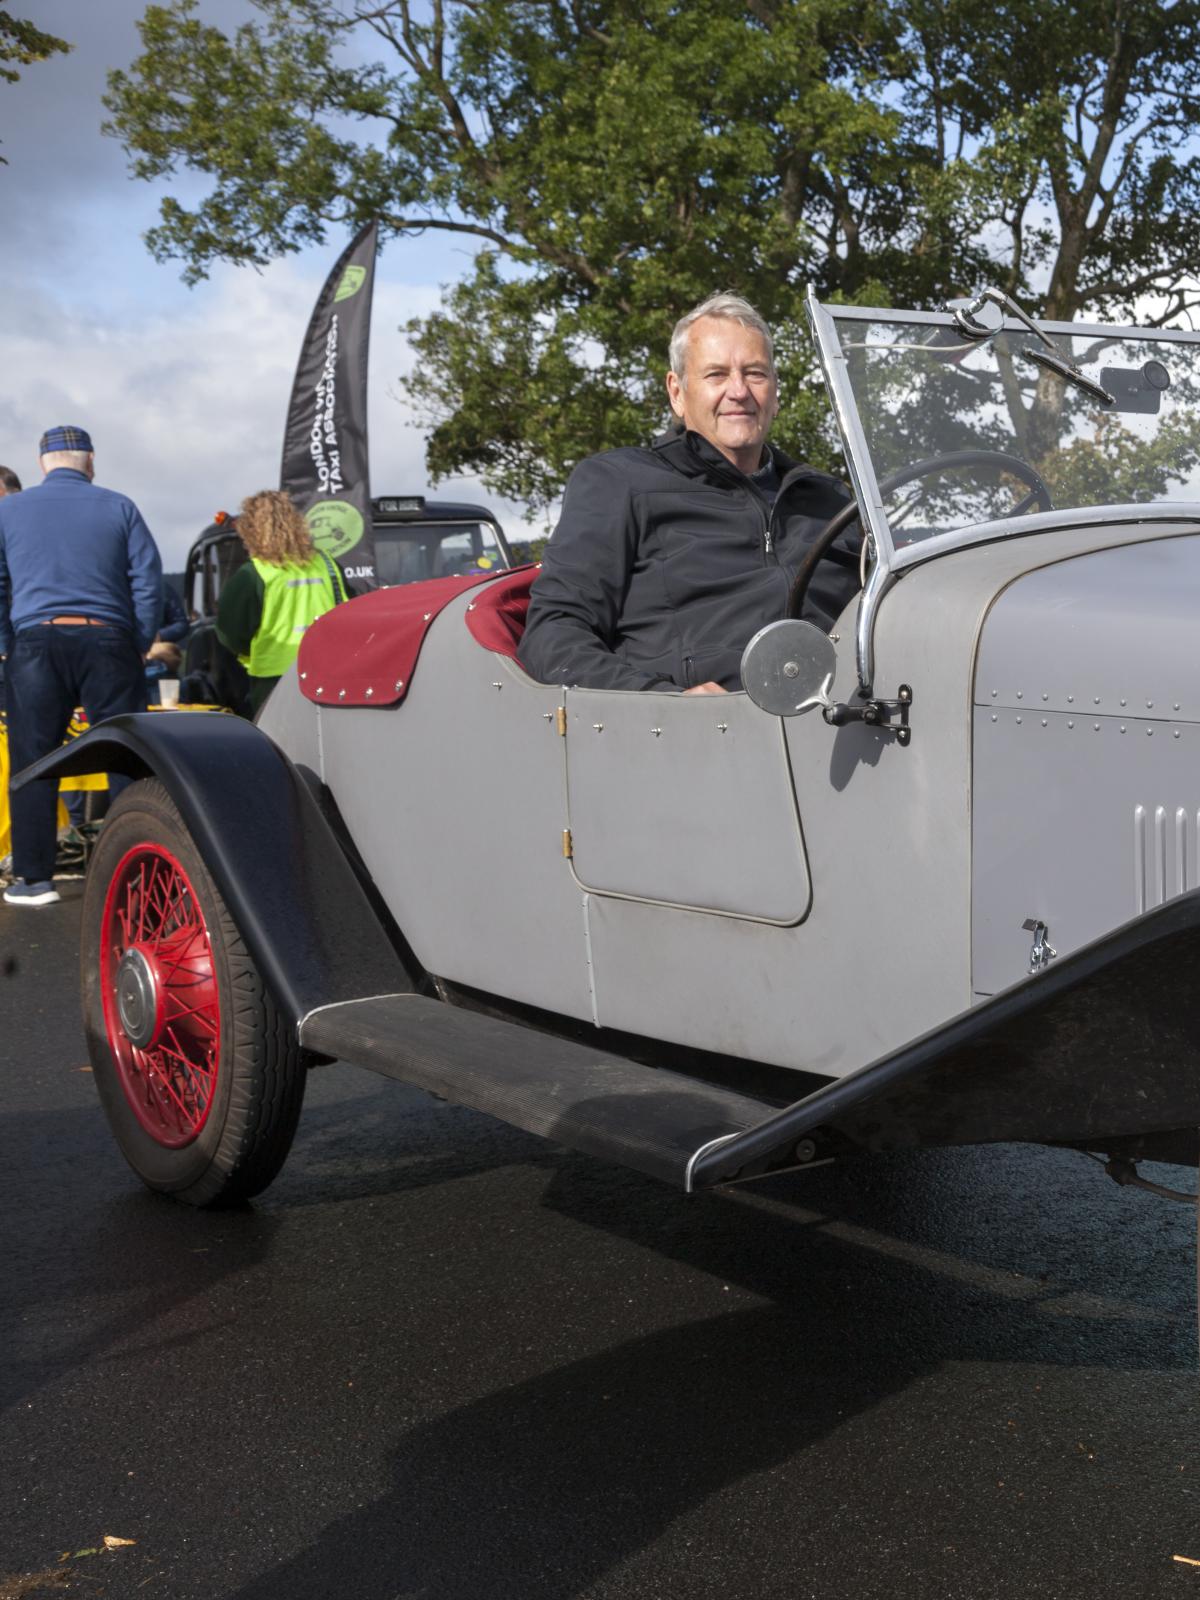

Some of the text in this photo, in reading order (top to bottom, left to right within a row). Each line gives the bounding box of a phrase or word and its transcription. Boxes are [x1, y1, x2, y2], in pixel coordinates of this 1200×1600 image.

[324, 313, 344, 494] TAXI ASSOCI
[310, 413, 330, 492] LONDON
[379, 500, 398, 512] FOR
